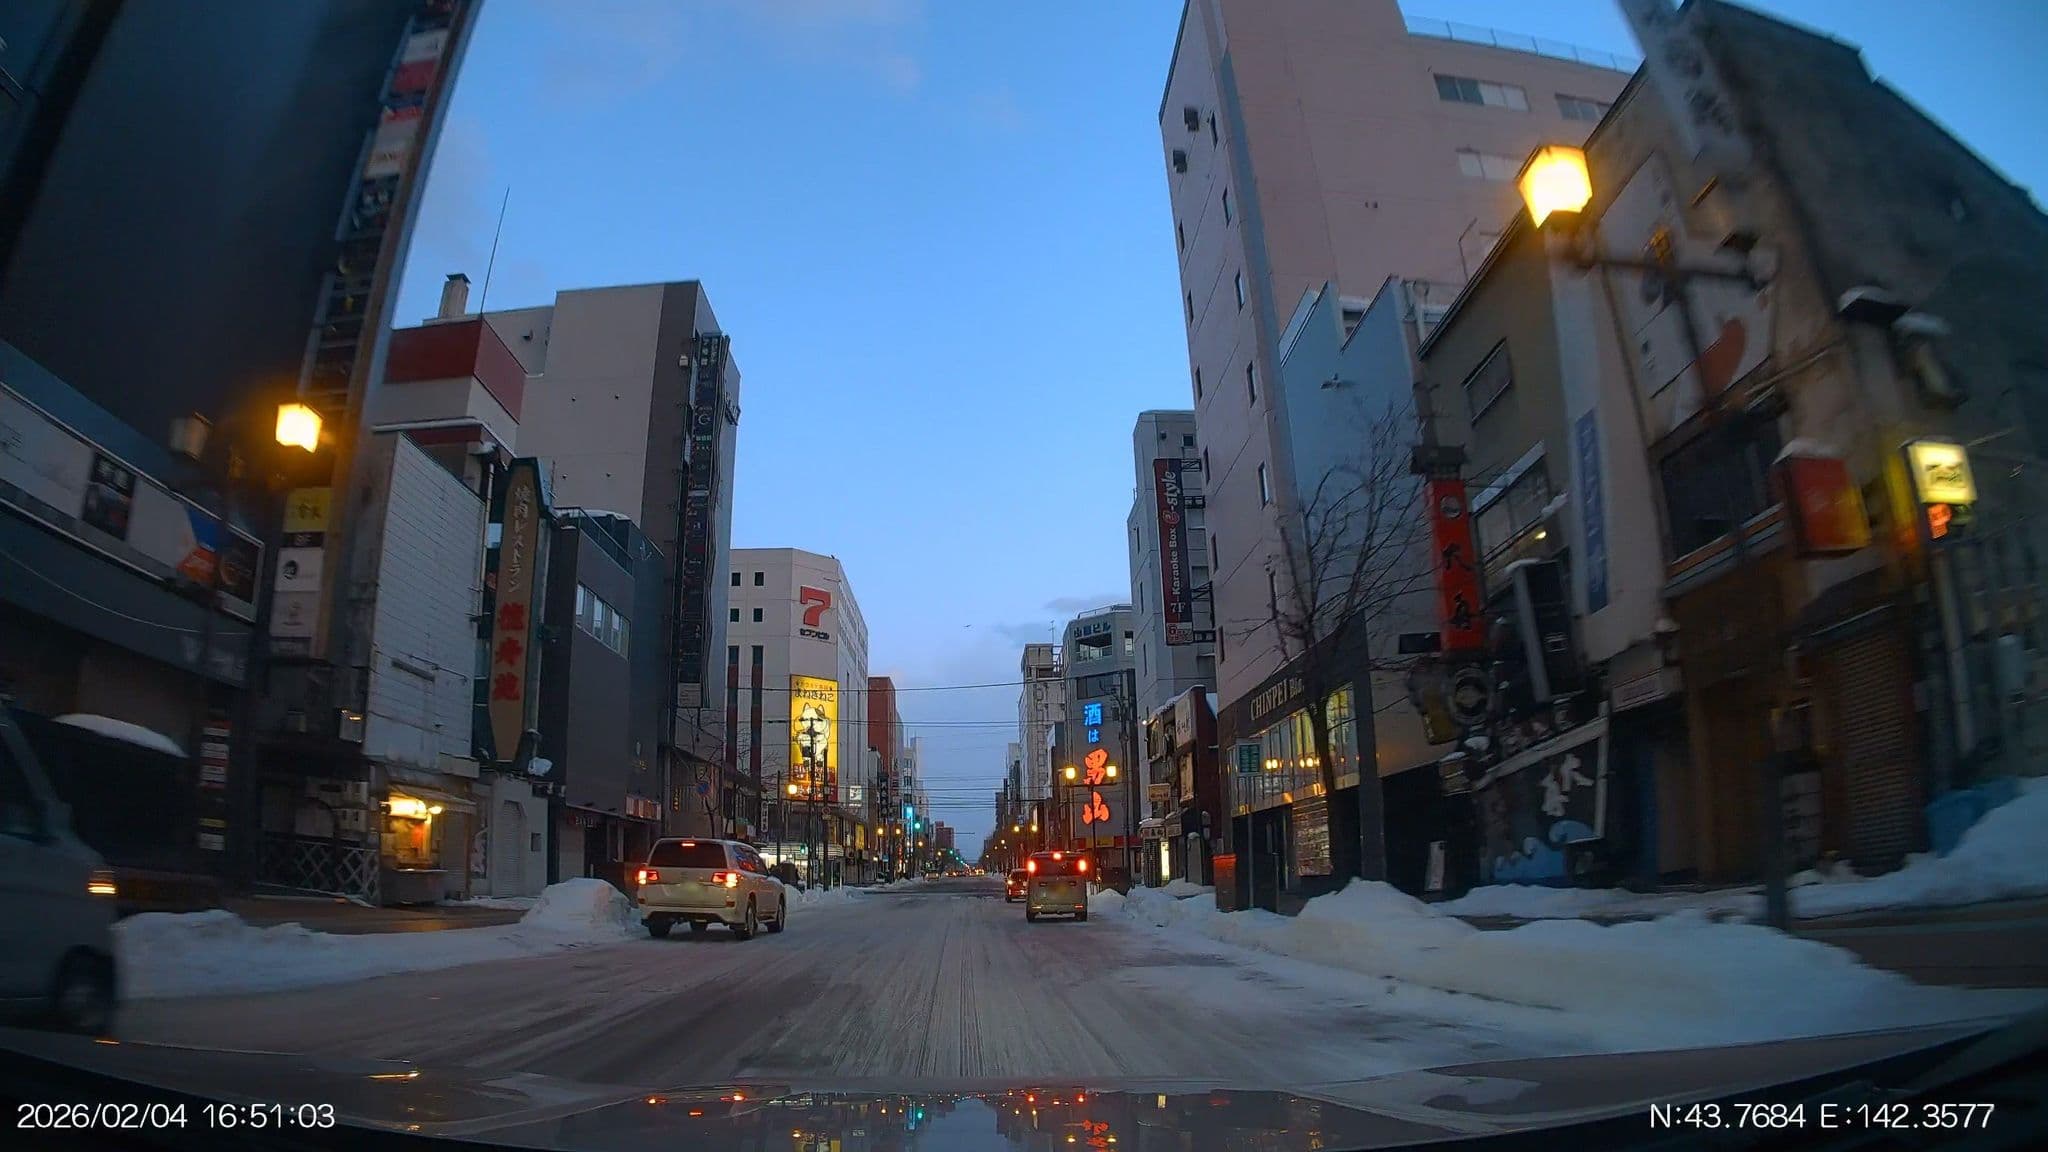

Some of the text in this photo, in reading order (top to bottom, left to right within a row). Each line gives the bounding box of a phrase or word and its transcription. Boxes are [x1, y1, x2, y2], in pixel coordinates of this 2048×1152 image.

[1168, 528, 1178, 548] Box
[1169, 550, 1181, 596] Karaoke
[800, 586, 831, 627] 7
[1170, 602, 1186, 614] 7F
[800, 628, 830, 641] セブンビル
[795, 687, 835, 703] まねきねこ
[1250, 678, 1288, 721] CHINPEI
